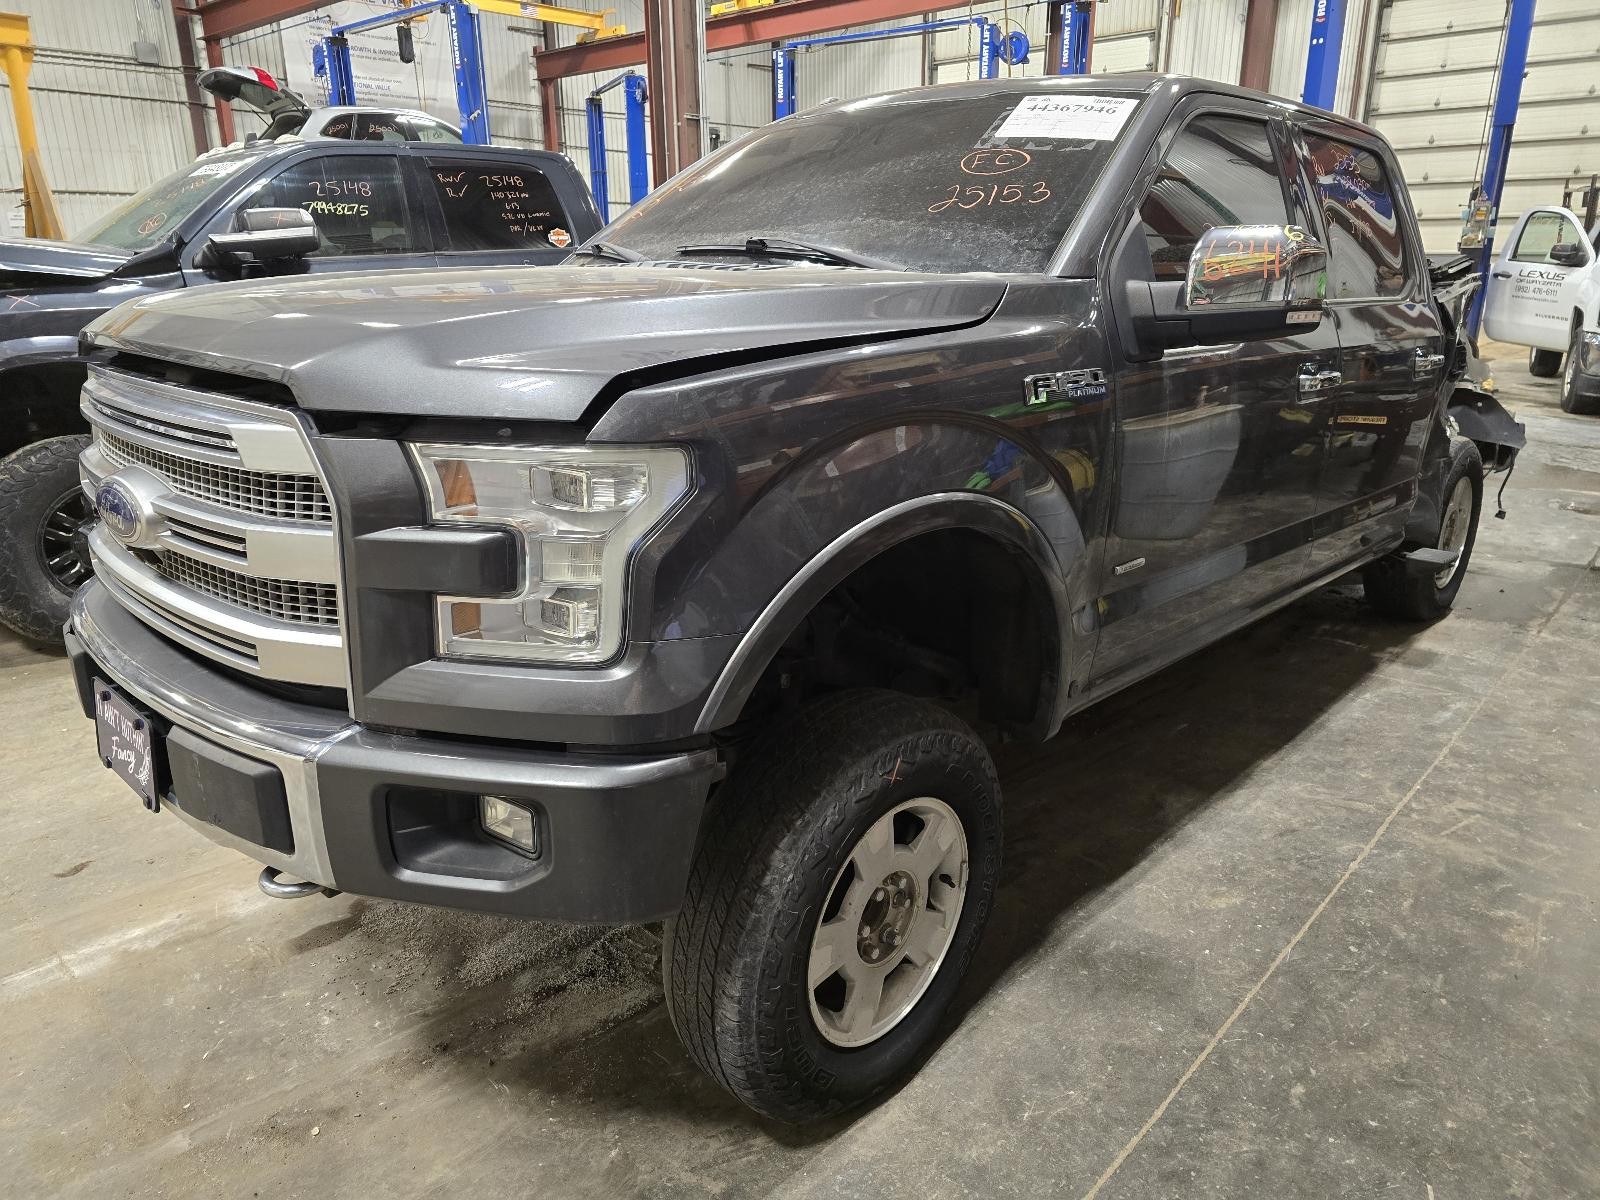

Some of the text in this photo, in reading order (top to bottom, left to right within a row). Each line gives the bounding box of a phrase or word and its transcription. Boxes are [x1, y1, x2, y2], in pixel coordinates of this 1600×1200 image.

[351, 45, 372, 54] ROWTH
[452, 27, 460, 65] ROTARY
[1062, 26, 1070, 63] ROTARY
[982, 44, 990, 78] ROTARY
[1027, 103, 1118, 115] 44367946
[308, 180, 372, 197] 25148
[479, 175, 524, 187] 25148
[928, 181, 1051, 213] 25153
[1519, 269, 1567, 281] LEXUS
[1069, 385, 1106, 397] PLATINUM
[111, 735, 137, 774] Fancy
